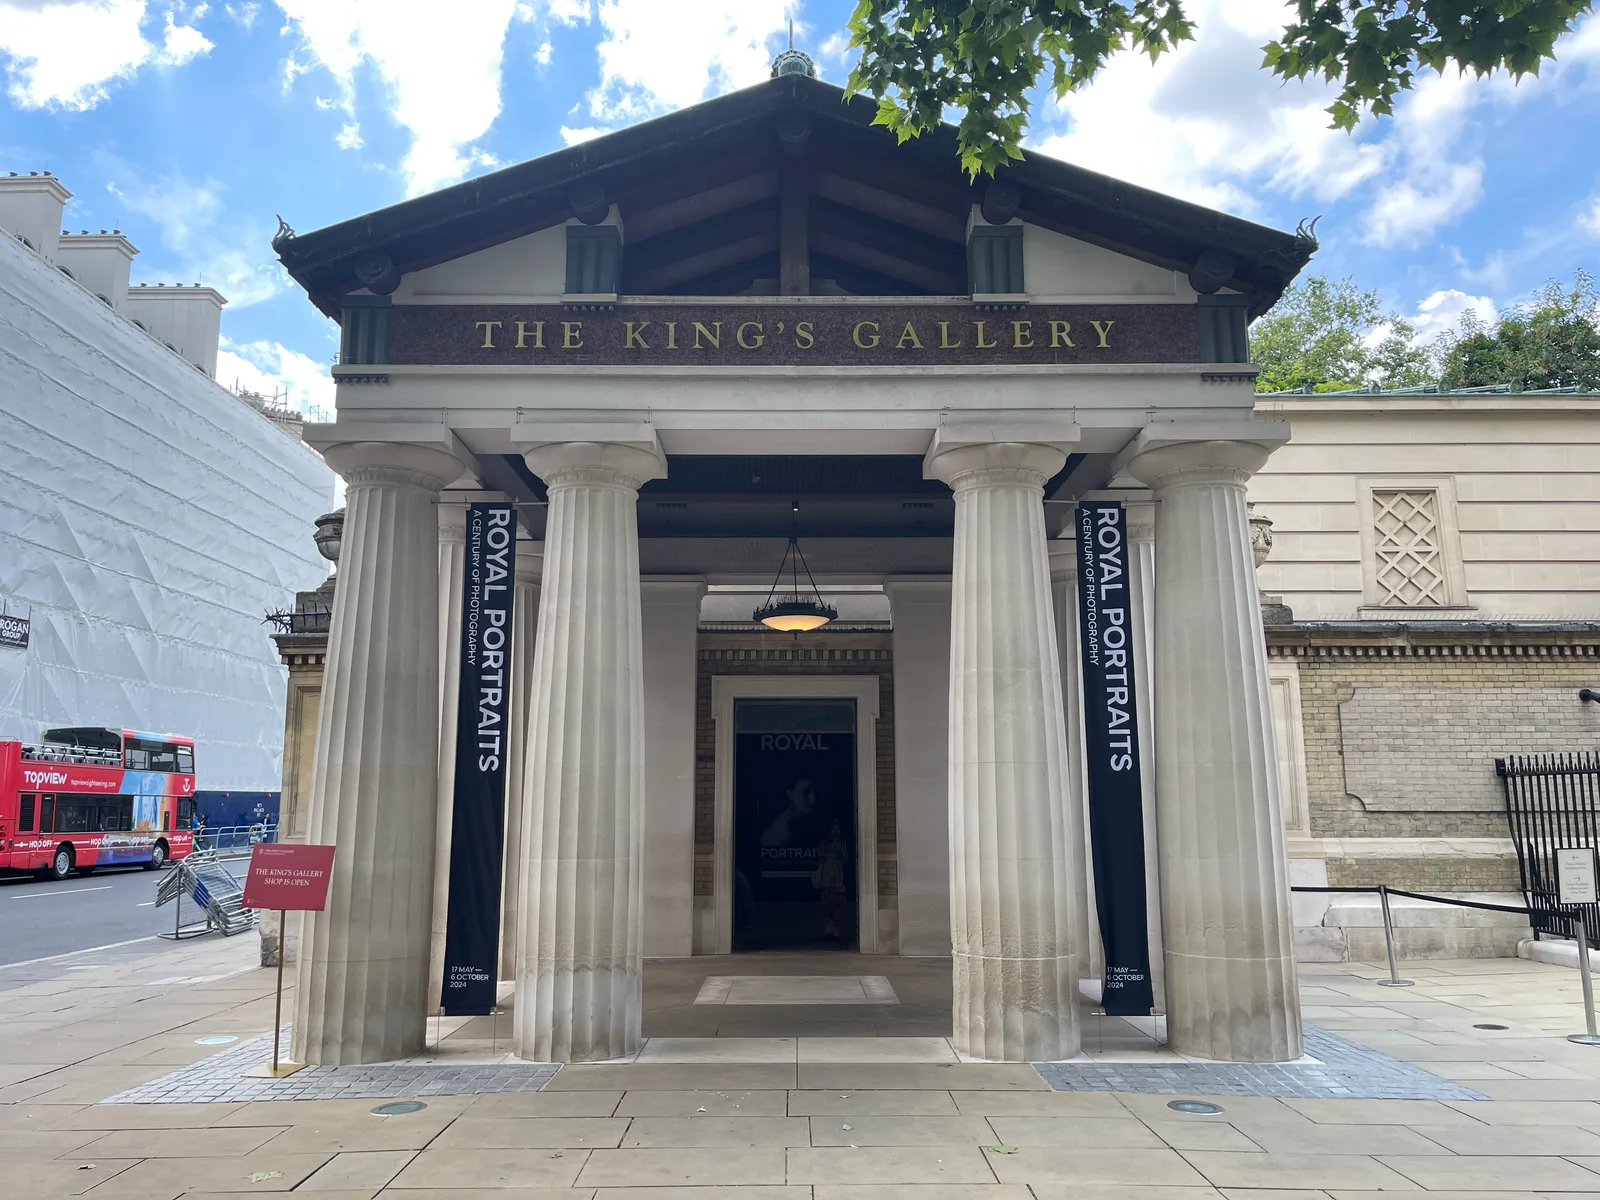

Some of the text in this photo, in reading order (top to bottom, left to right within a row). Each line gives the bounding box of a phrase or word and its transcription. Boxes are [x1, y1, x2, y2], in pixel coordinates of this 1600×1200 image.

[475, 320, 1116, 350] THE KING'S GALLERY
[467, 509, 483, 666] A CENTURY OF PHOTOGRAPHY
[1082, 508, 1099, 666] A CENTURY OF PHOTOGRAPHY
[0, 618, 28, 634] ROGAN
[1, 630, 21, 639] GROUP
[477, 509, 511, 772] ROYAL PORTRAITS
[1097, 508, 1133, 772] ROYAL PORTRAITS
[760, 734, 829, 751] ROYAL
[760, 847, 818, 859] PORTRAI
[255, 868, 324, 878] THE KING'S GALLERY
[264, 877, 310, 887] SHOP IS OPEN
[456, 973, 489, 981] OCTOBER
